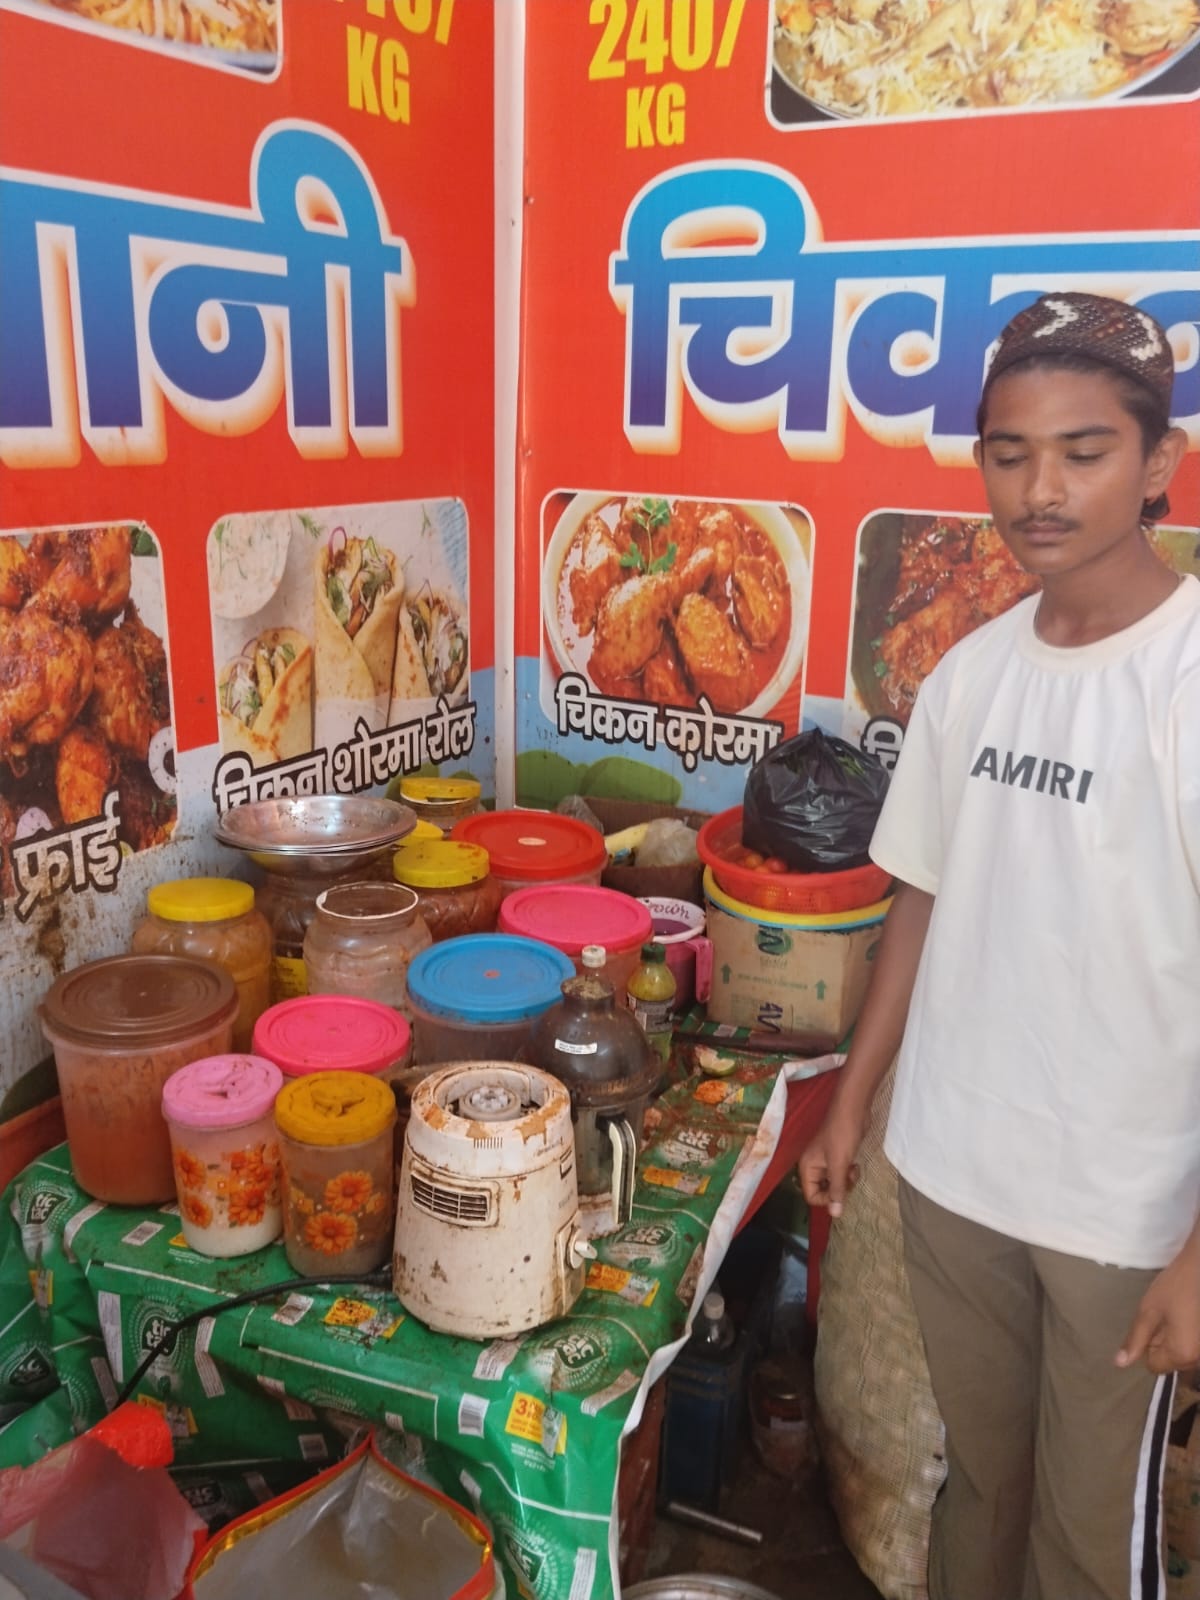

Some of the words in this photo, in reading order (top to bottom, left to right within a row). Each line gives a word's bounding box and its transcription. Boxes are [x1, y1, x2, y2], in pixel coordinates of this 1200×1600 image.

[347, 24, 410, 125] KG
[626, 82, 686, 149] KG
[332, 720, 423, 794] शोरमा
[426, 703, 477, 764] रोल
[555, 675, 659, 748] चिकन
[970, 747, 1094, 804] AMIRI
[12, 790, 121, 916] फ्राई
